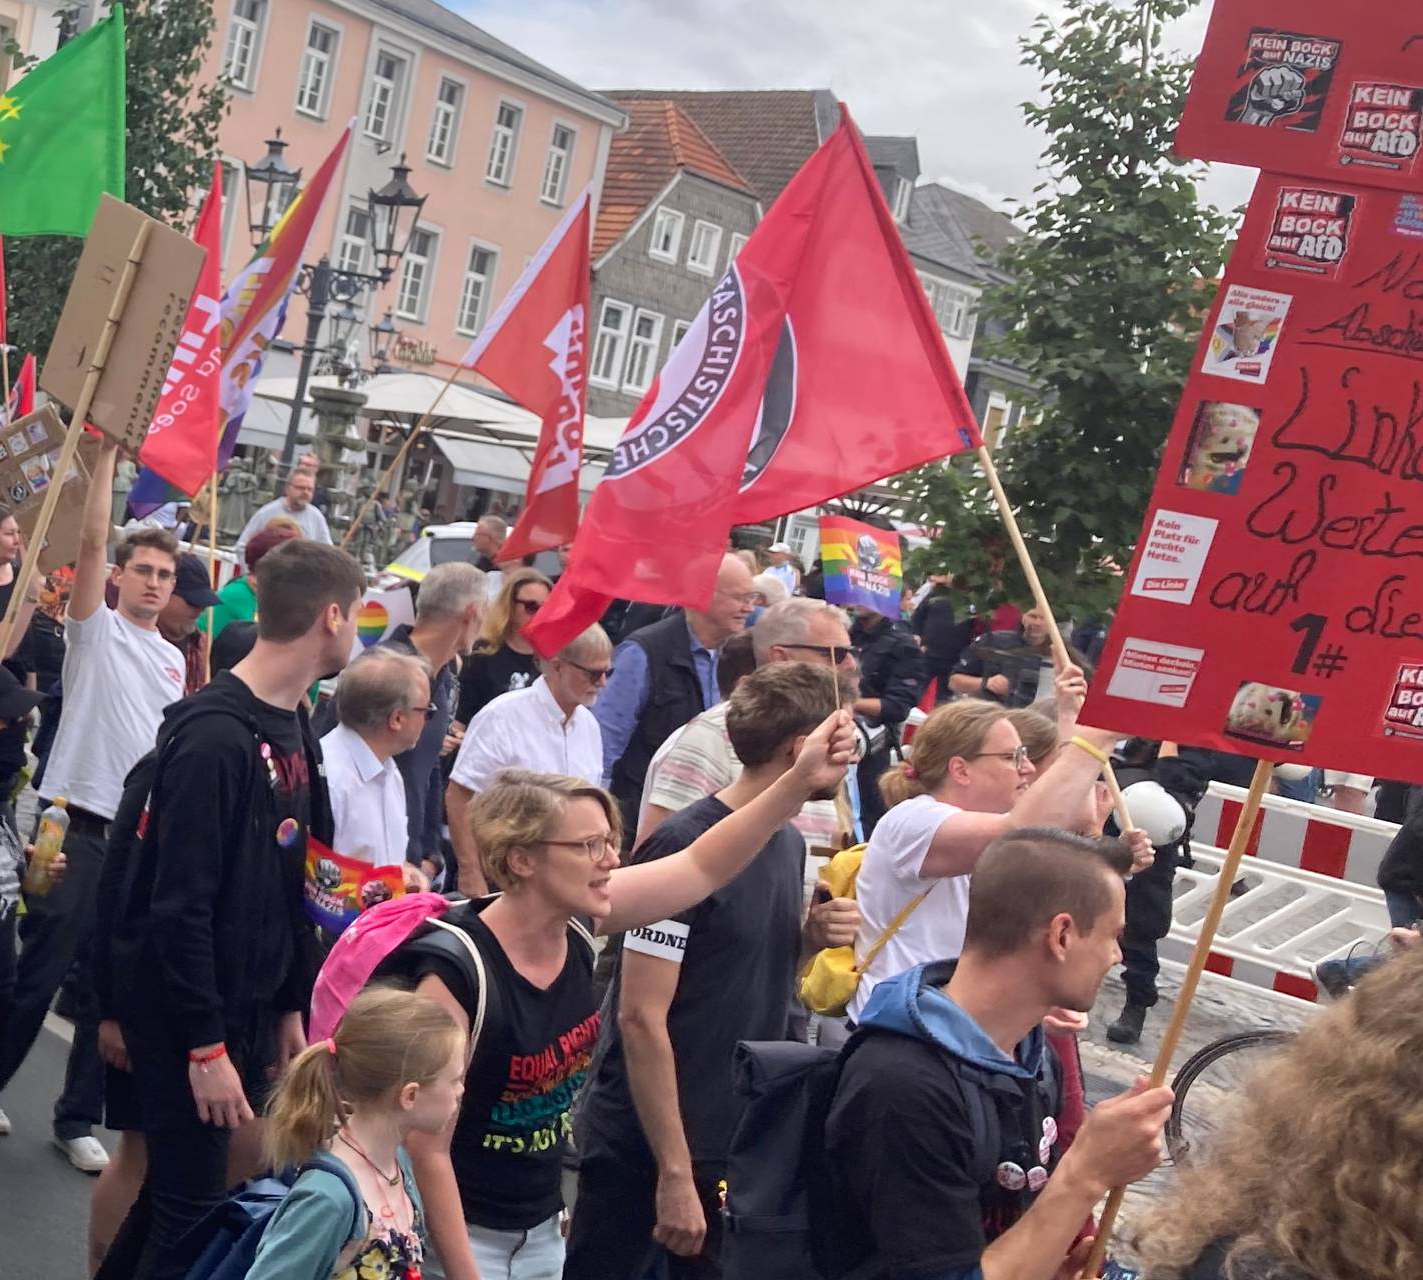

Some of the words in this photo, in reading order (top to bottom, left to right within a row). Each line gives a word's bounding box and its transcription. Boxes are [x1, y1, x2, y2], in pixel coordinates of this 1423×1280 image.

[1250, 36, 1288, 51] KEIN
[1290, 40, 1333, 55] BOCK
[1262, 50, 1282, 60] auf
[1283, 50, 1333, 70] NAZIS
[1354, 86, 1412, 107] KEIN
[1353, 111, 1418, 129] BOCK
[1343, 131, 1373, 145] auf
[1370, 129, 1418, 155] AfD
[1281, 191, 1339, 212] KEIN
[1279, 215, 1345, 236] BOCK
[1270, 235, 1301, 248] auf
[1297, 234, 1343, 260] AfD
[1157, 519, 1181, 530] Kein
[1150, 541, 1185, 553] rechte
[1153, 529, 1182, 541] Platz
[1183, 534, 1201, 545] für
[1146, 549, 1182, 563] Hetze.
[1209, 549, 1317, 616] auf
[508, 1044, 560, 1081] EQUAL
